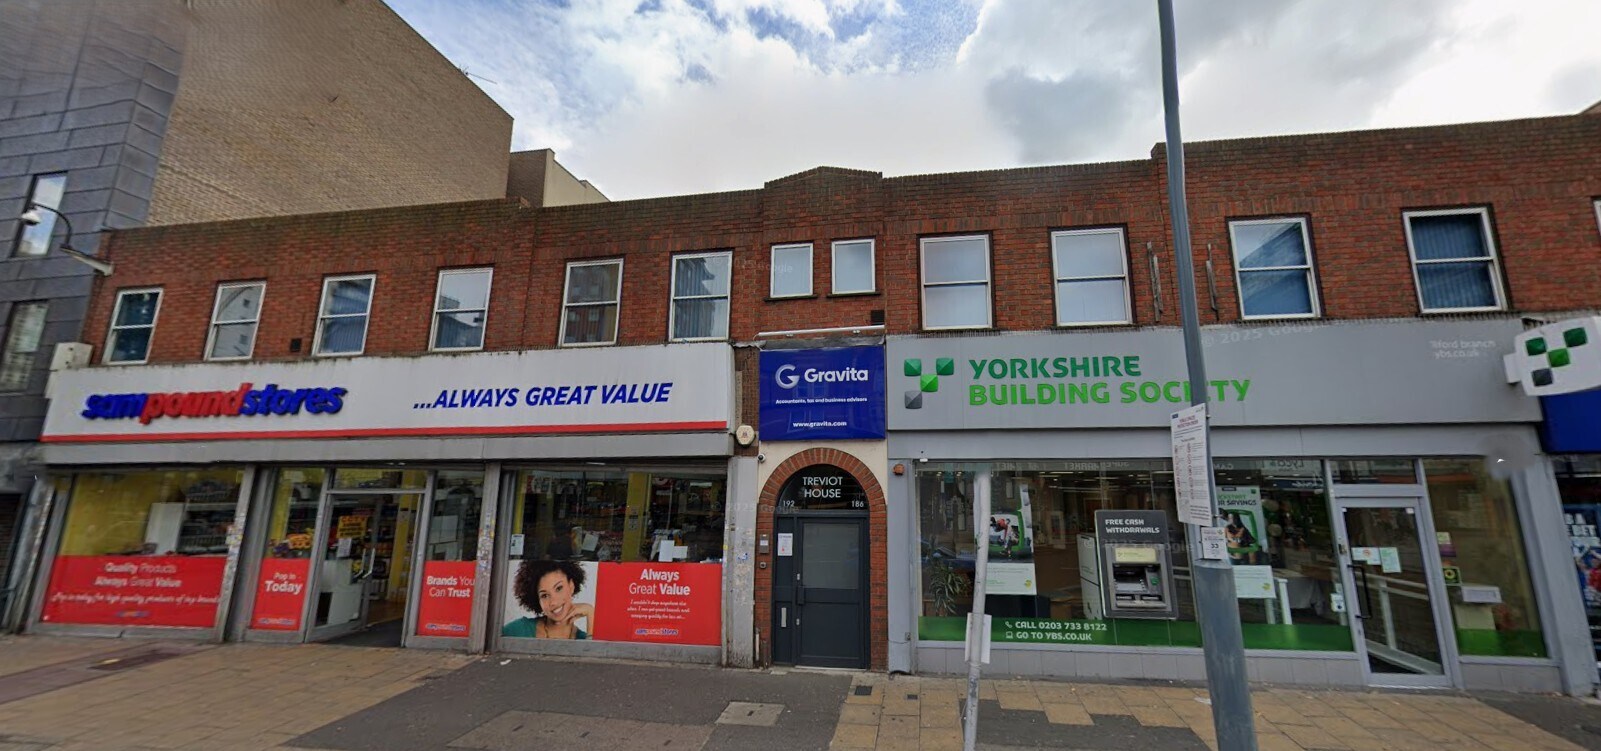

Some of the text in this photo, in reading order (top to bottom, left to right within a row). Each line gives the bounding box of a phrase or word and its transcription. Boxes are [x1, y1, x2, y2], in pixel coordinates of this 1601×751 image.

[968, 355, 1142, 380] YORKSHIRE
[804, 366, 868, 383] Gravita
[525, 384, 597, 407] GREAT
[601, 382, 673, 404] VALUE
[969, 379, 1250, 406] BUILDING SOCITY
[792, 420, 847, 428] www.gravita.com
[802, 476, 843, 486] TREVIOT
[804, 488, 841, 498] HOUSE
[851, 500, 864, 508] 186
[105, 562, 138, 574] Quality
[273, 572, 288, 580] Pop
[427, 575, 458, 585] Brands
[640, 568, 680, 583] Always
[94, 577, 128, 588] Always
[155, 577, 182, 588] Value
[264, 580, 302, 595] Today
[429, 587, 470, 598] Can Trust
[629, 582, 691, 596] Great Value
[1015, 621, 1107, 631] CALL 0203 733 8122
[1016, 631, 1093, 640] GO TO YBS.CO.UK
